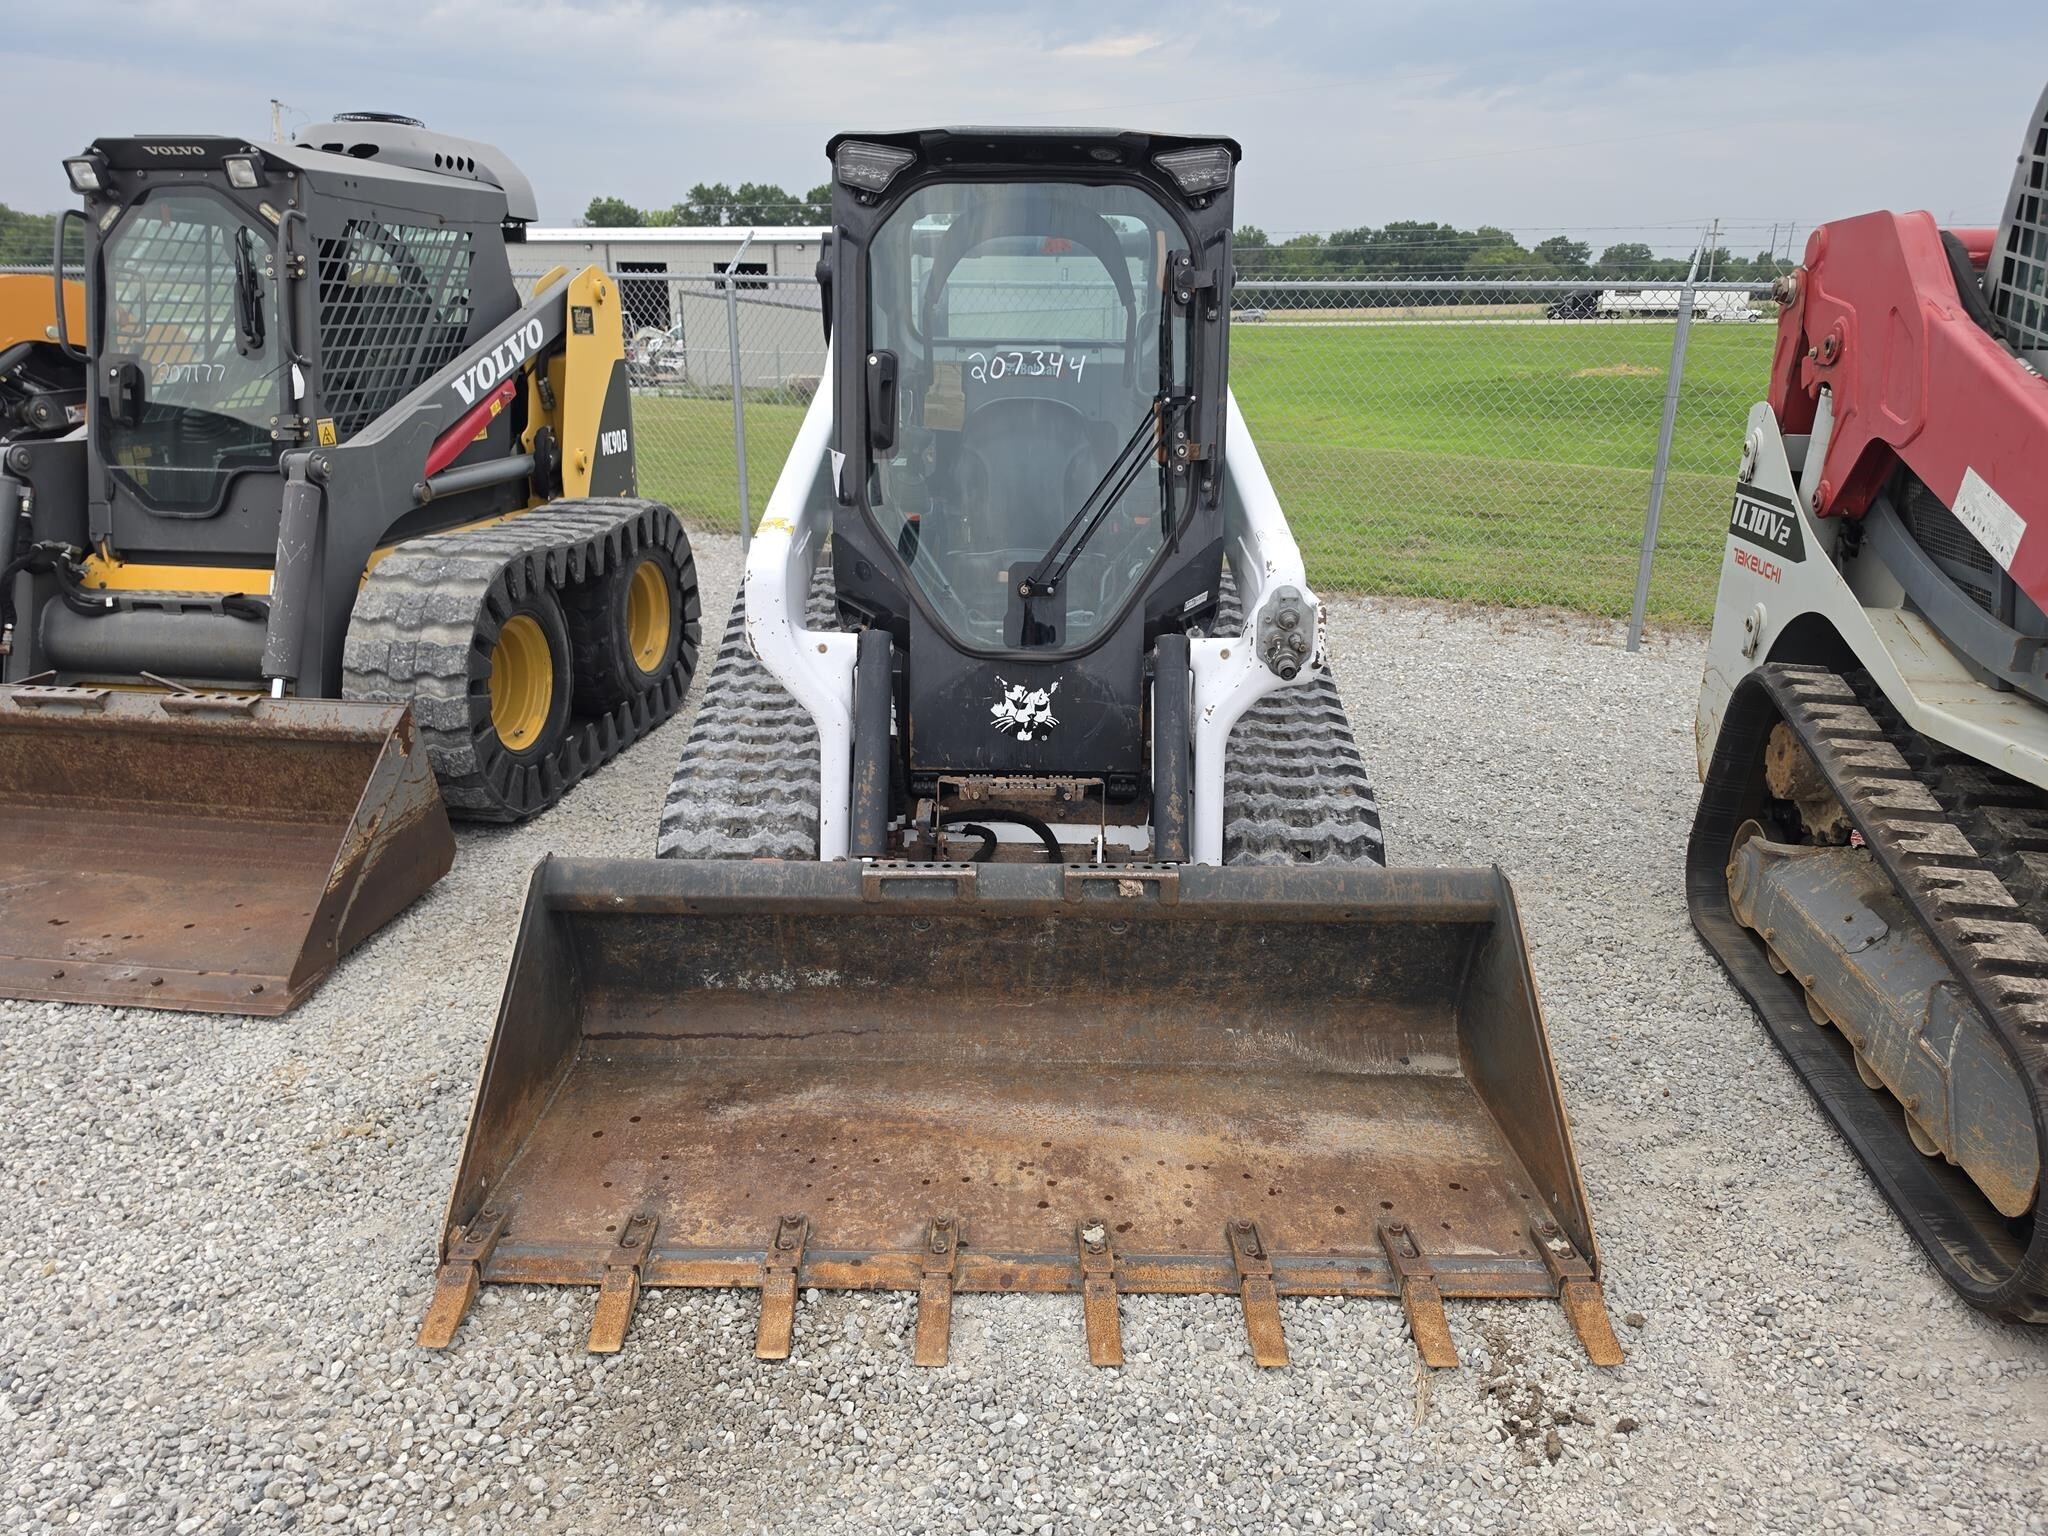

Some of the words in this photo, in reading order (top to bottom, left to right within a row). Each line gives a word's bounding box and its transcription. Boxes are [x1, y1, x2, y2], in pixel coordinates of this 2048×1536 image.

[142, 146, 206, 156] VOLVO
[451, 318, 544, 405] VOLVO
[968, 350, 1086, 383] 207344
